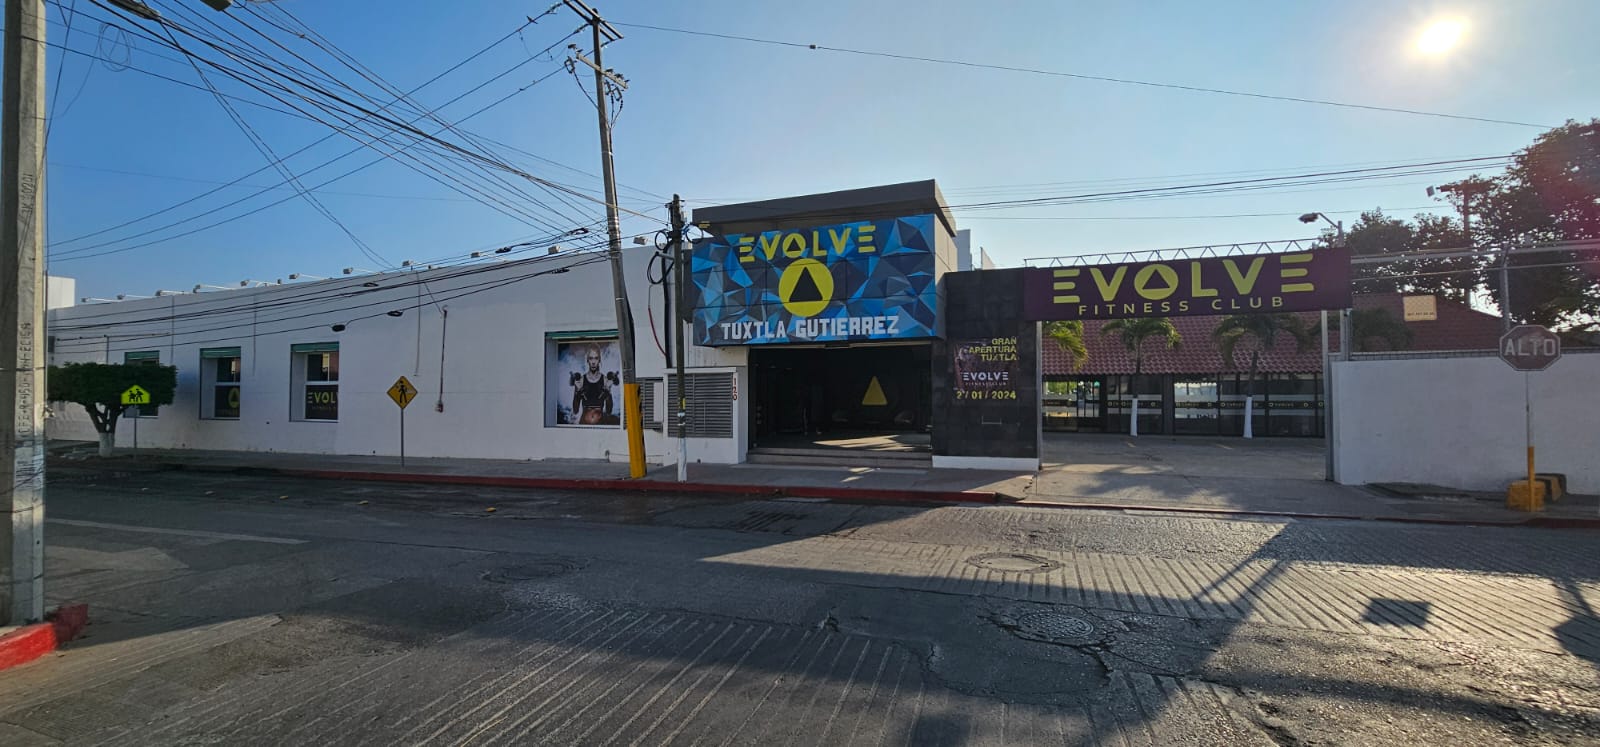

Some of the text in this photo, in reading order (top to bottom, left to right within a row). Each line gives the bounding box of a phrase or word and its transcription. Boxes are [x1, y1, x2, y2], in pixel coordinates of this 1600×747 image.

[739, 225, 876, 263] EVOLVE
[1053, 253, 1314, 304] EVOLVE
[1078, 297, 1283, 316] FITNESS CLUB
[721, 316, 899, 340] TUXTLA GUTIERREZ
[1503, 339, 1556, 356] ALTO
[962, 371, 1009, 381] EVOLVE
[308, 391, 338, 403] EVOL
